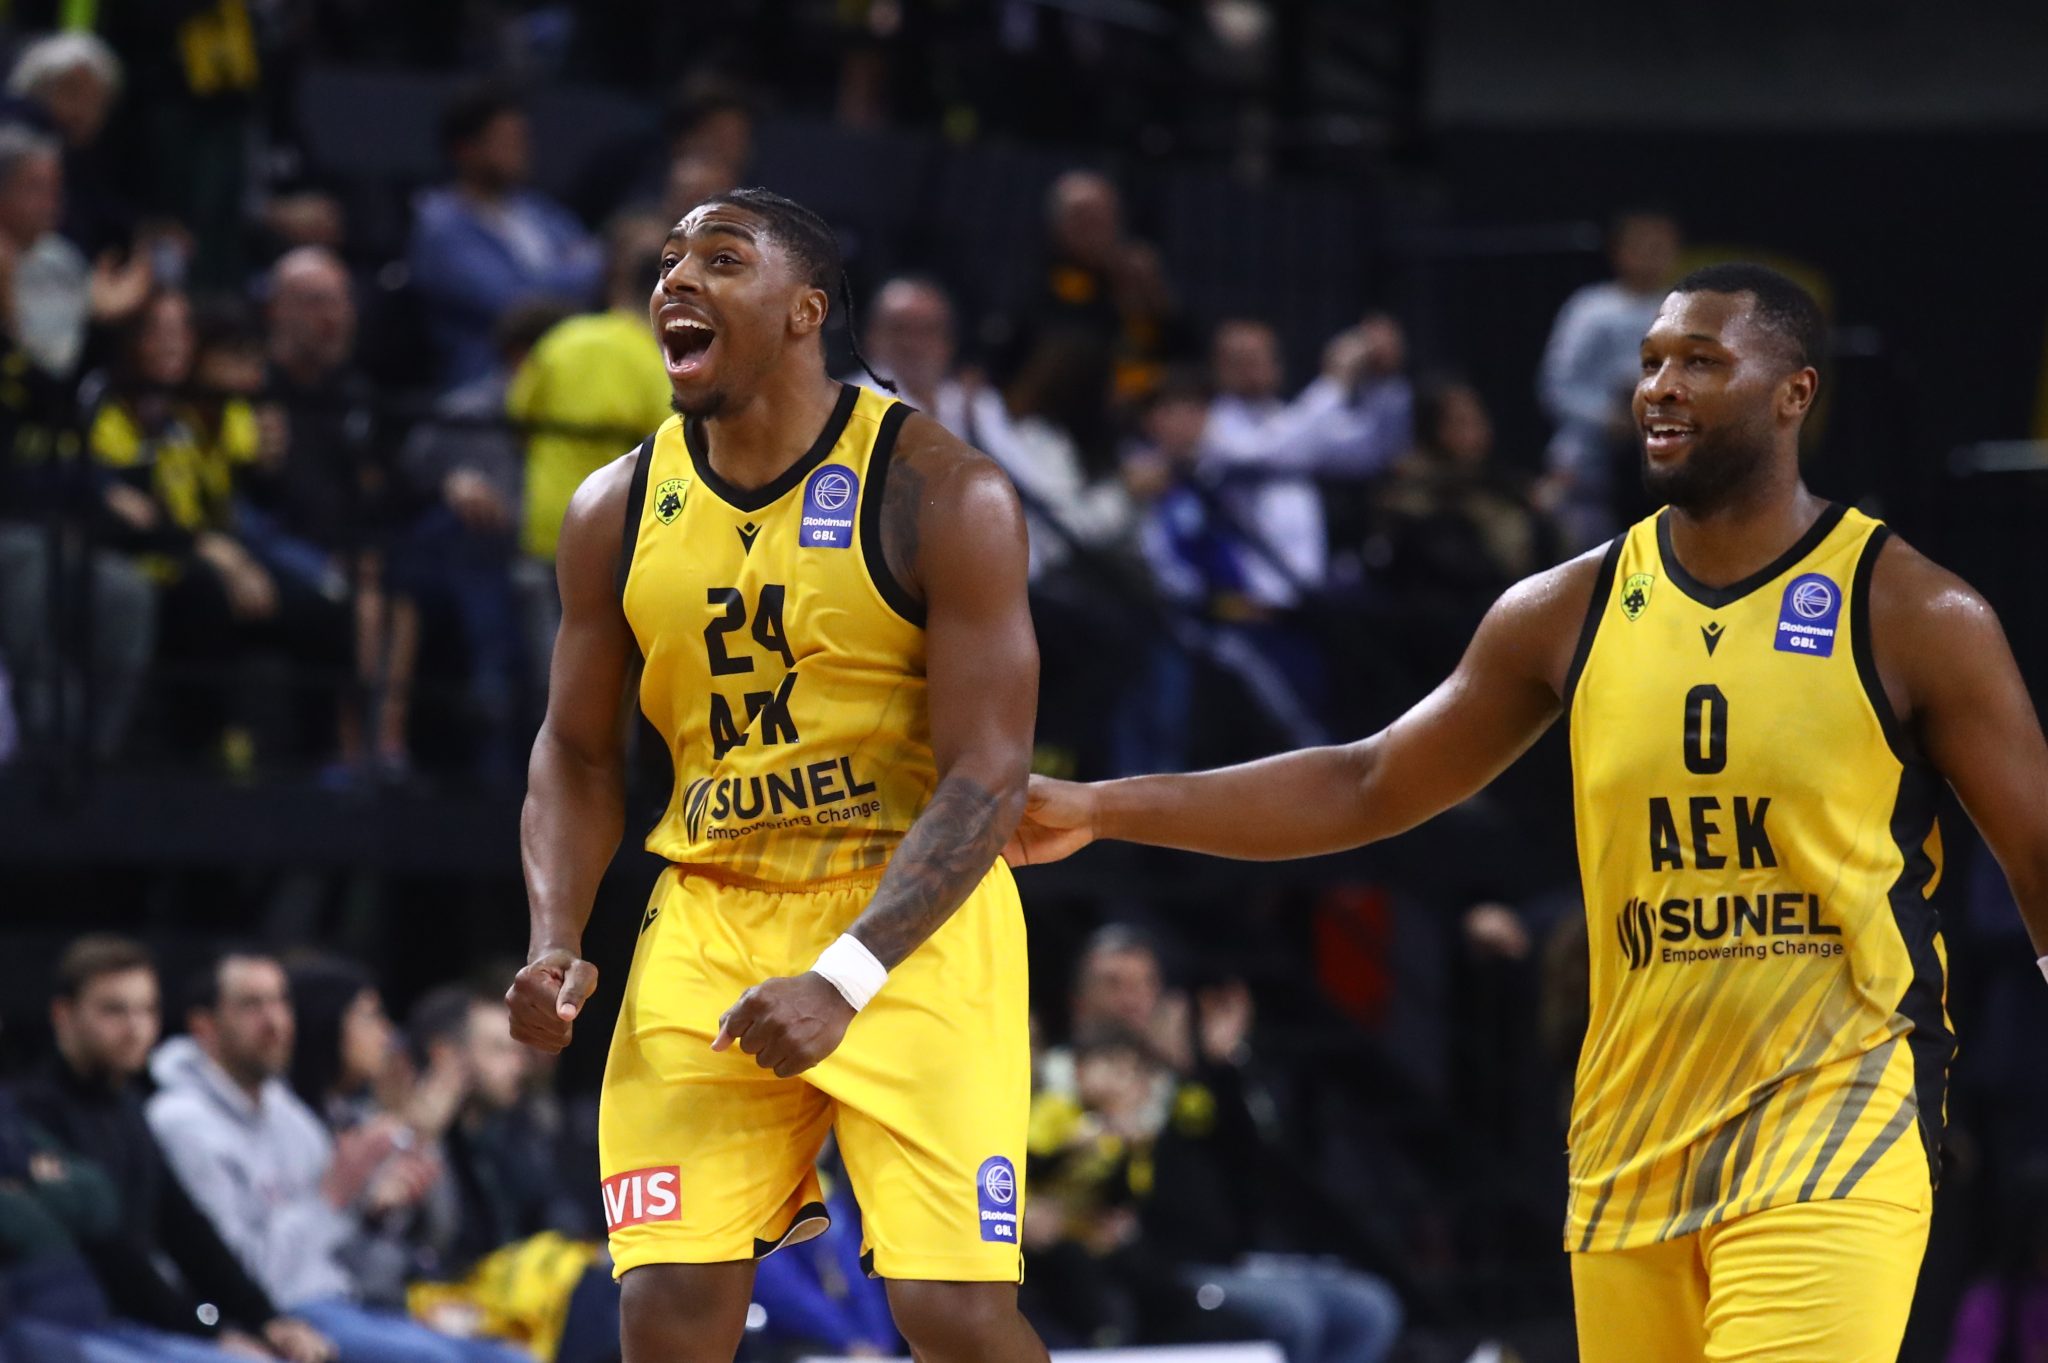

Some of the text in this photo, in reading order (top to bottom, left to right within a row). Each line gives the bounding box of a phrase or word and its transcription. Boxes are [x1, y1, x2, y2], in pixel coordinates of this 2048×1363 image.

[812, 530, 837, 541] GBL
[704, 584, 794, 676] 24
[1790, 636, 1817, 649] GBL
[1683, 684, 1728, 775] 0
[711, 756, 876, 821] SUNEL
[706, 800, 881, 841] Empowering Change
[1649, 796, 1778, 872] AEK
[1660, 893, 1842, 942] SUNEL
[1662, 940, 1844, 964] Empowering Change
[994, 1224, 1012, 1236] GBL
